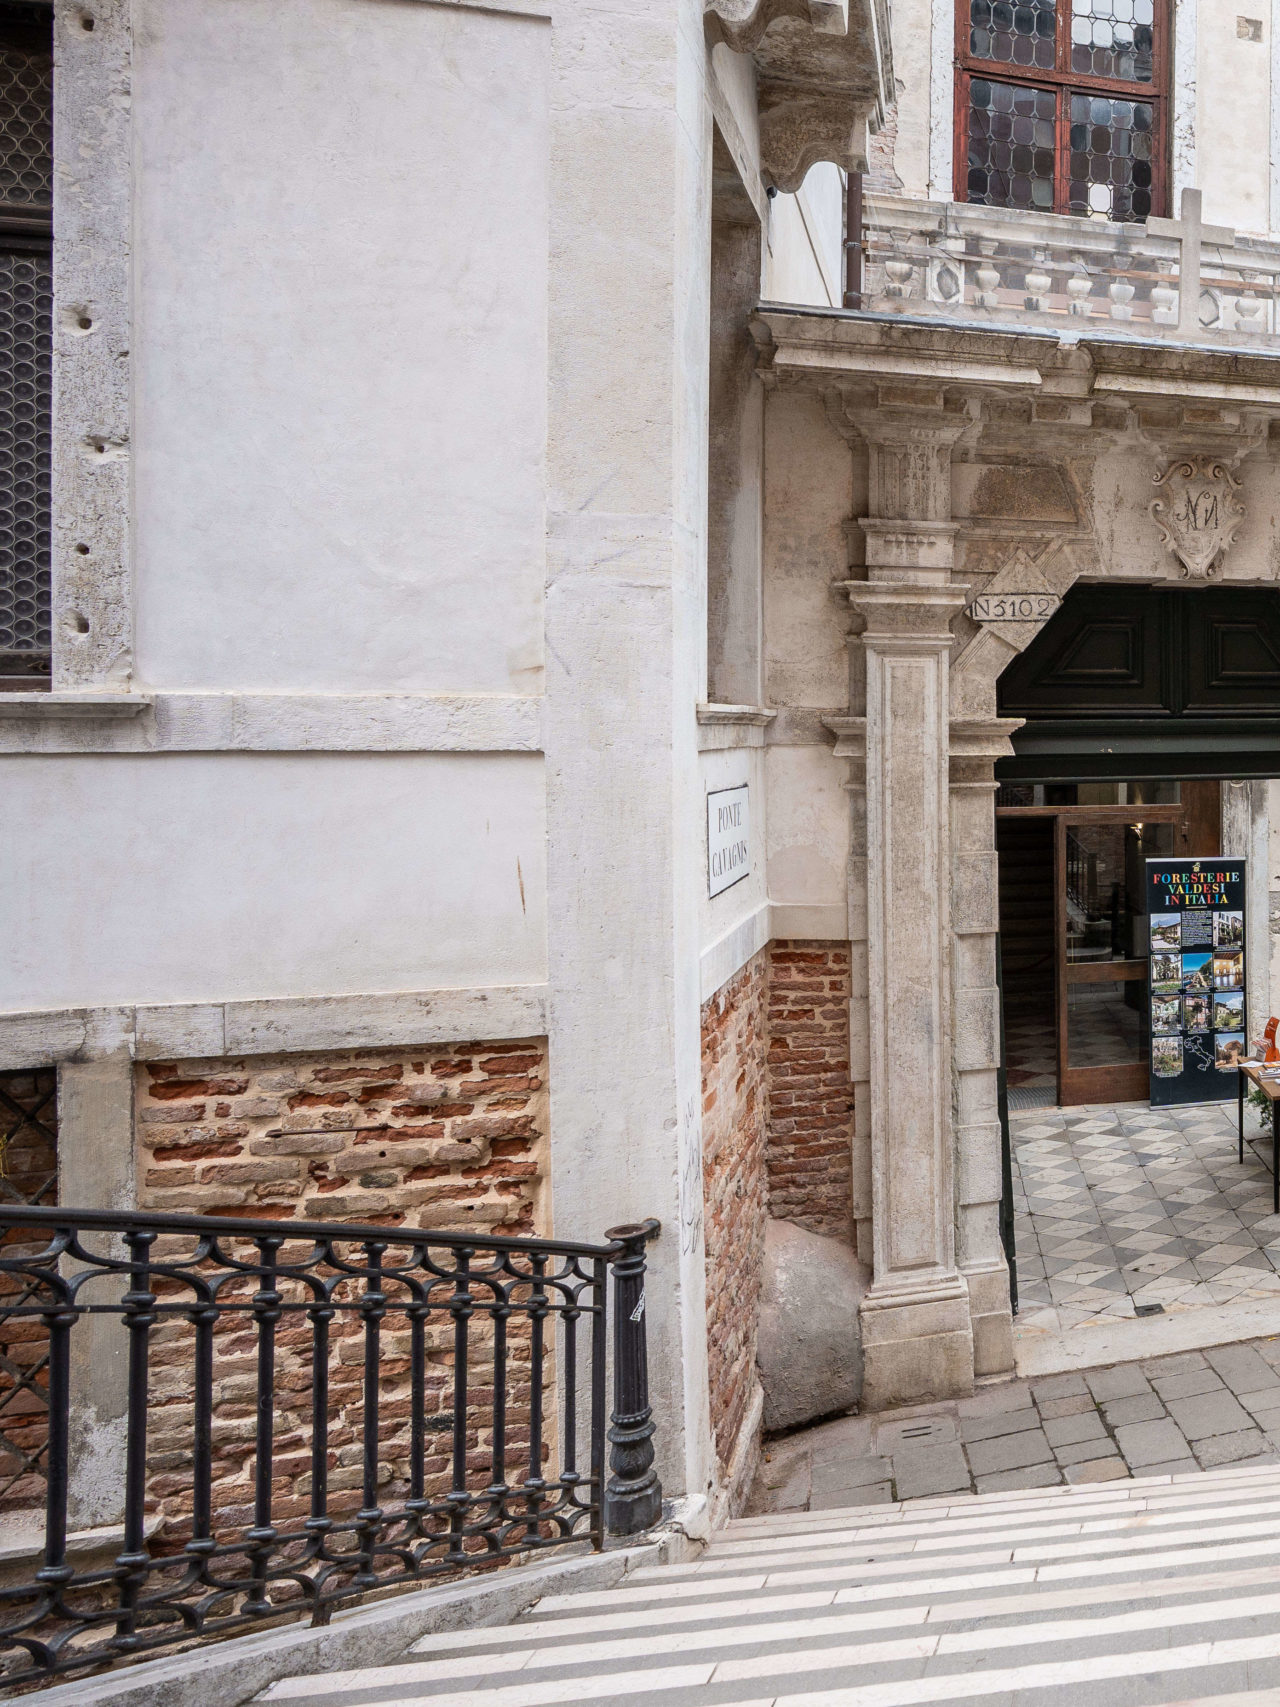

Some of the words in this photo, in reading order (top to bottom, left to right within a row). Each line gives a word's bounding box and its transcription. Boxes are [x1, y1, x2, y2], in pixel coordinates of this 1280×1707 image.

[718, 802, 742, 833] PONTE
[712, 840, 748, 877] CAVAGNIS
[1153, 872, 1240, 884] FORESTERIE
[1168, 883, 1226, 894] VALDESI
[1165, 895, 1180, 906] IN
[1185, 894, 1229, 905] ITALIA
